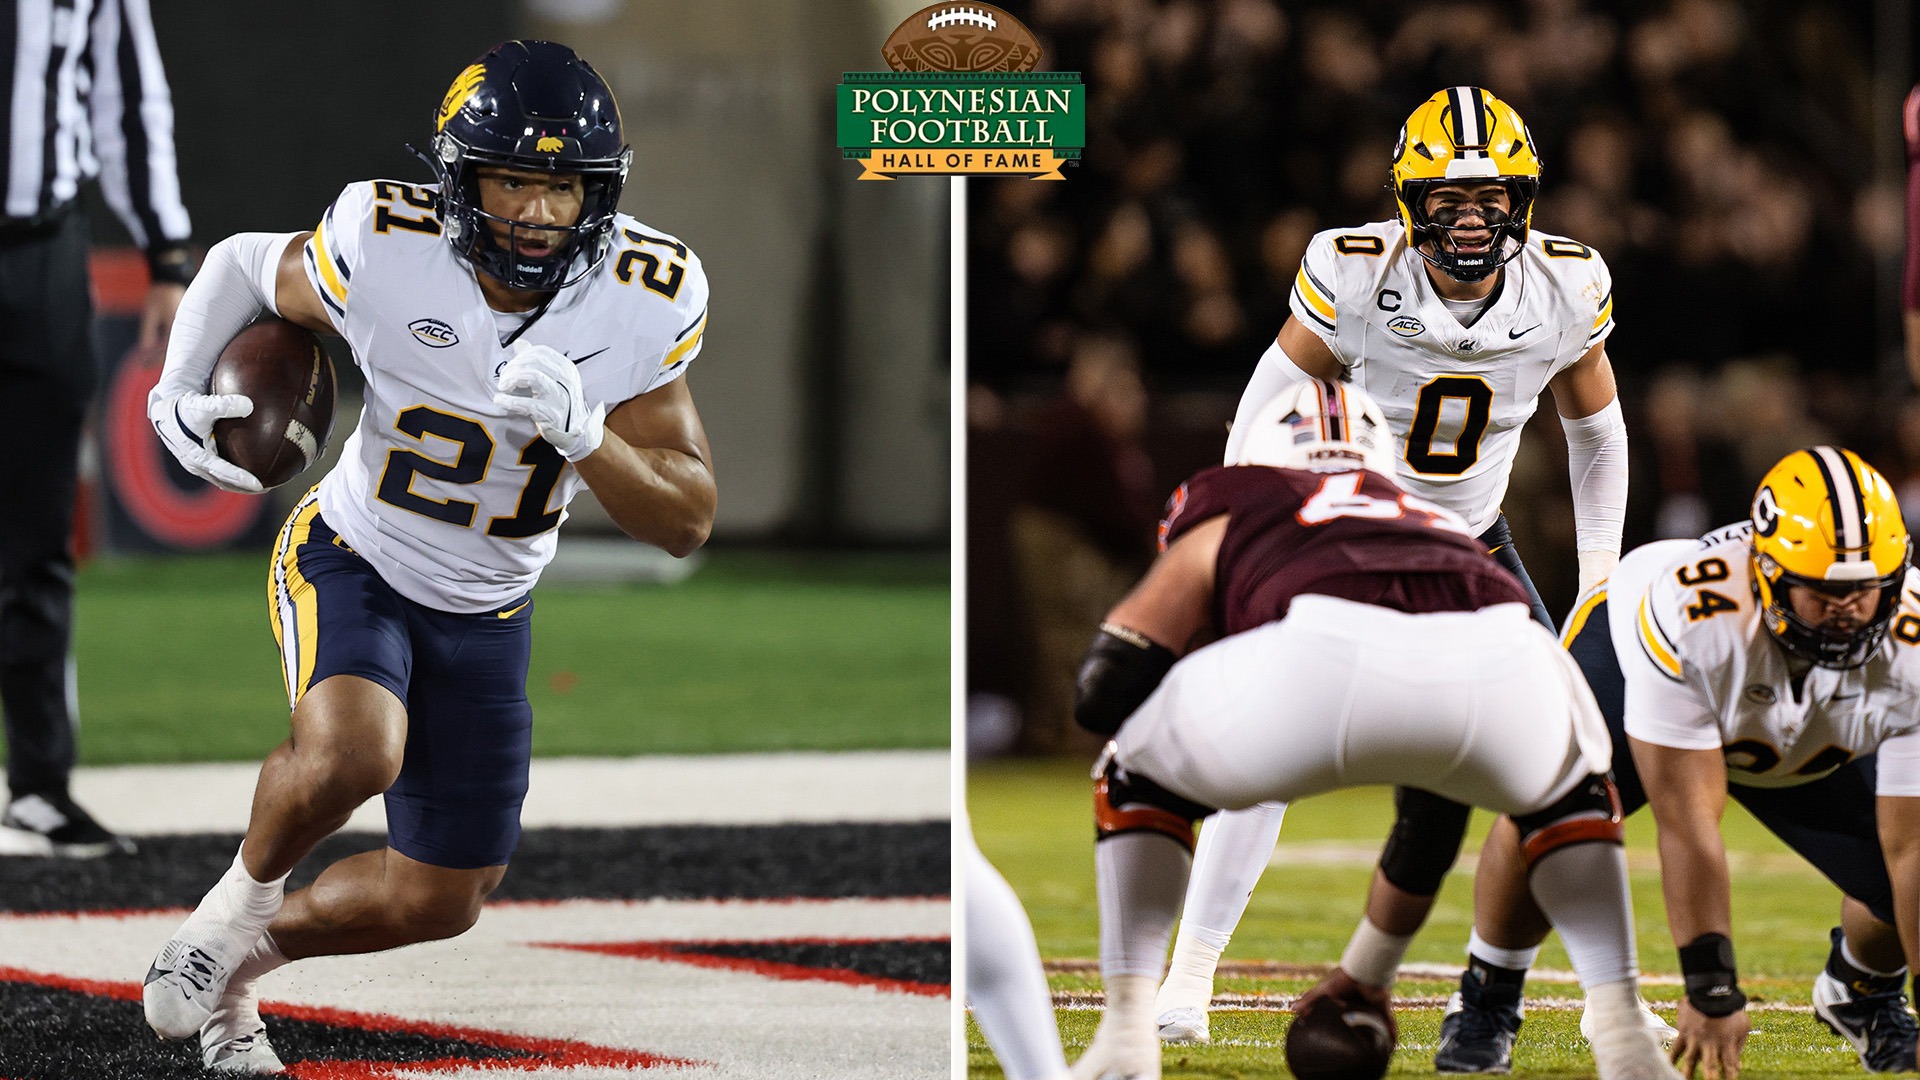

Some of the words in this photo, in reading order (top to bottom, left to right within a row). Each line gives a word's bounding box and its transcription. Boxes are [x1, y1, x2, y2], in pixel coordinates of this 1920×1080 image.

[372, 180, 443, 236] 21
[1333, 235, 1385, 257] 0
[1542, 239, 1592, 260] 0
[615, 227, 688, 302] 21
[1457, 258, 1484, 266] Riddell
[1377, 288, 1402, 312] C
[415, 325, 454, 341] ACC
[1391, 320, 1421, 331] ACC
[1404, 374, 1495, 476] 0
[375, 403, 563, 539] 21
[1675, 556, 1740, 623] 94
